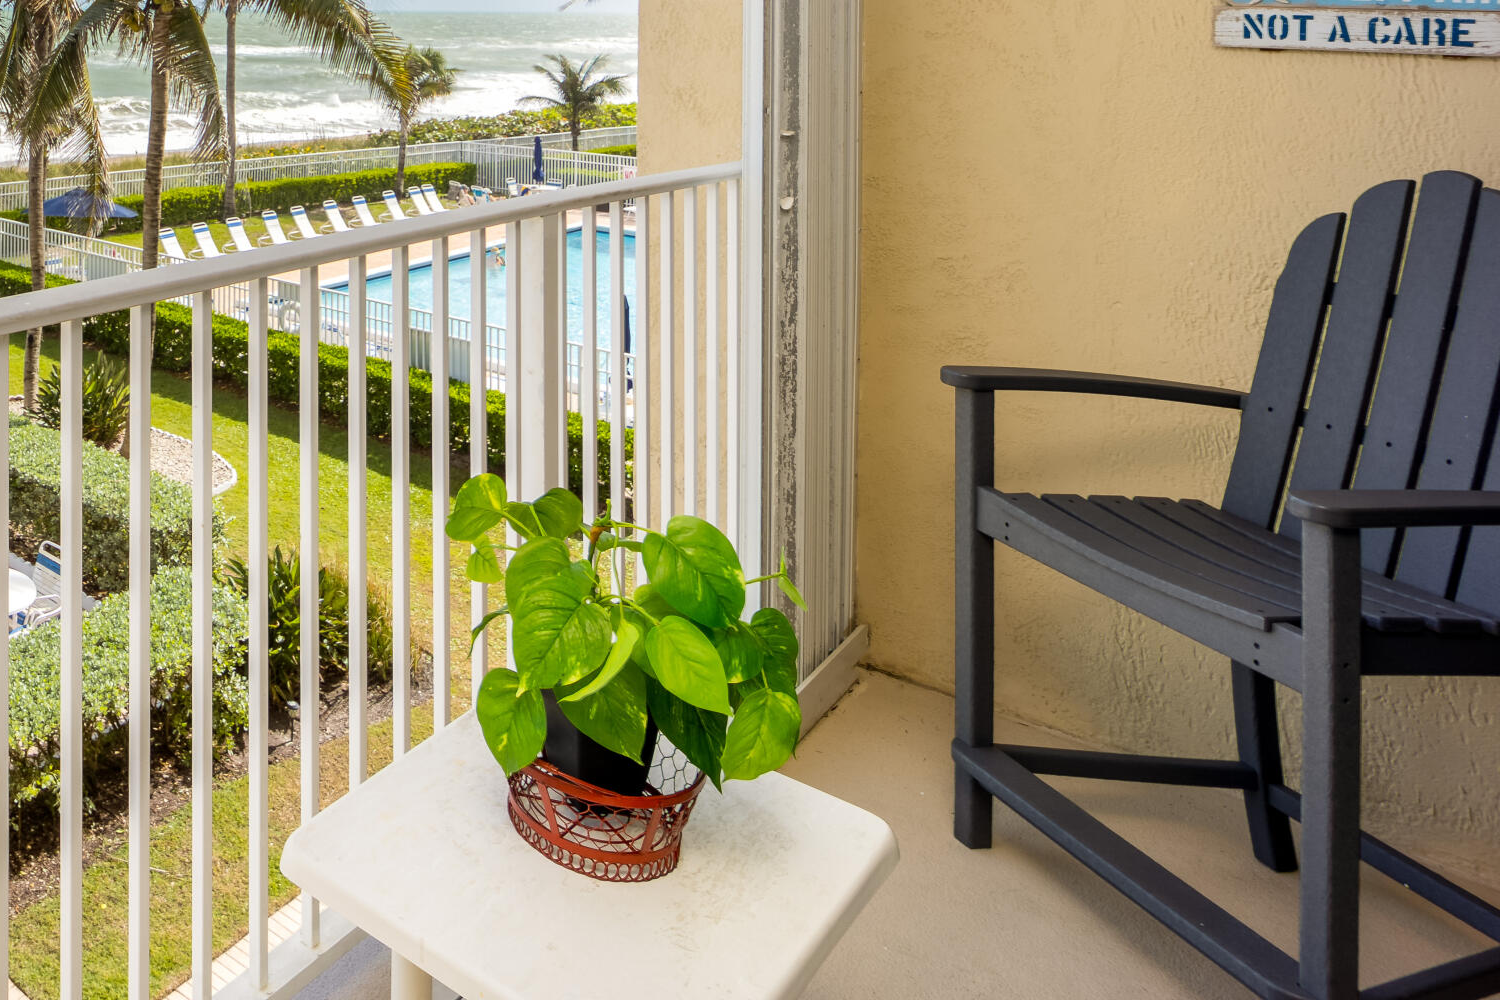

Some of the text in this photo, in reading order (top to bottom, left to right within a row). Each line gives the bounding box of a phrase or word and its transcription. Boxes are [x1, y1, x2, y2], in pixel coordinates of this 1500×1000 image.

[1243, 14, 1476, 47] NOT A CARE
